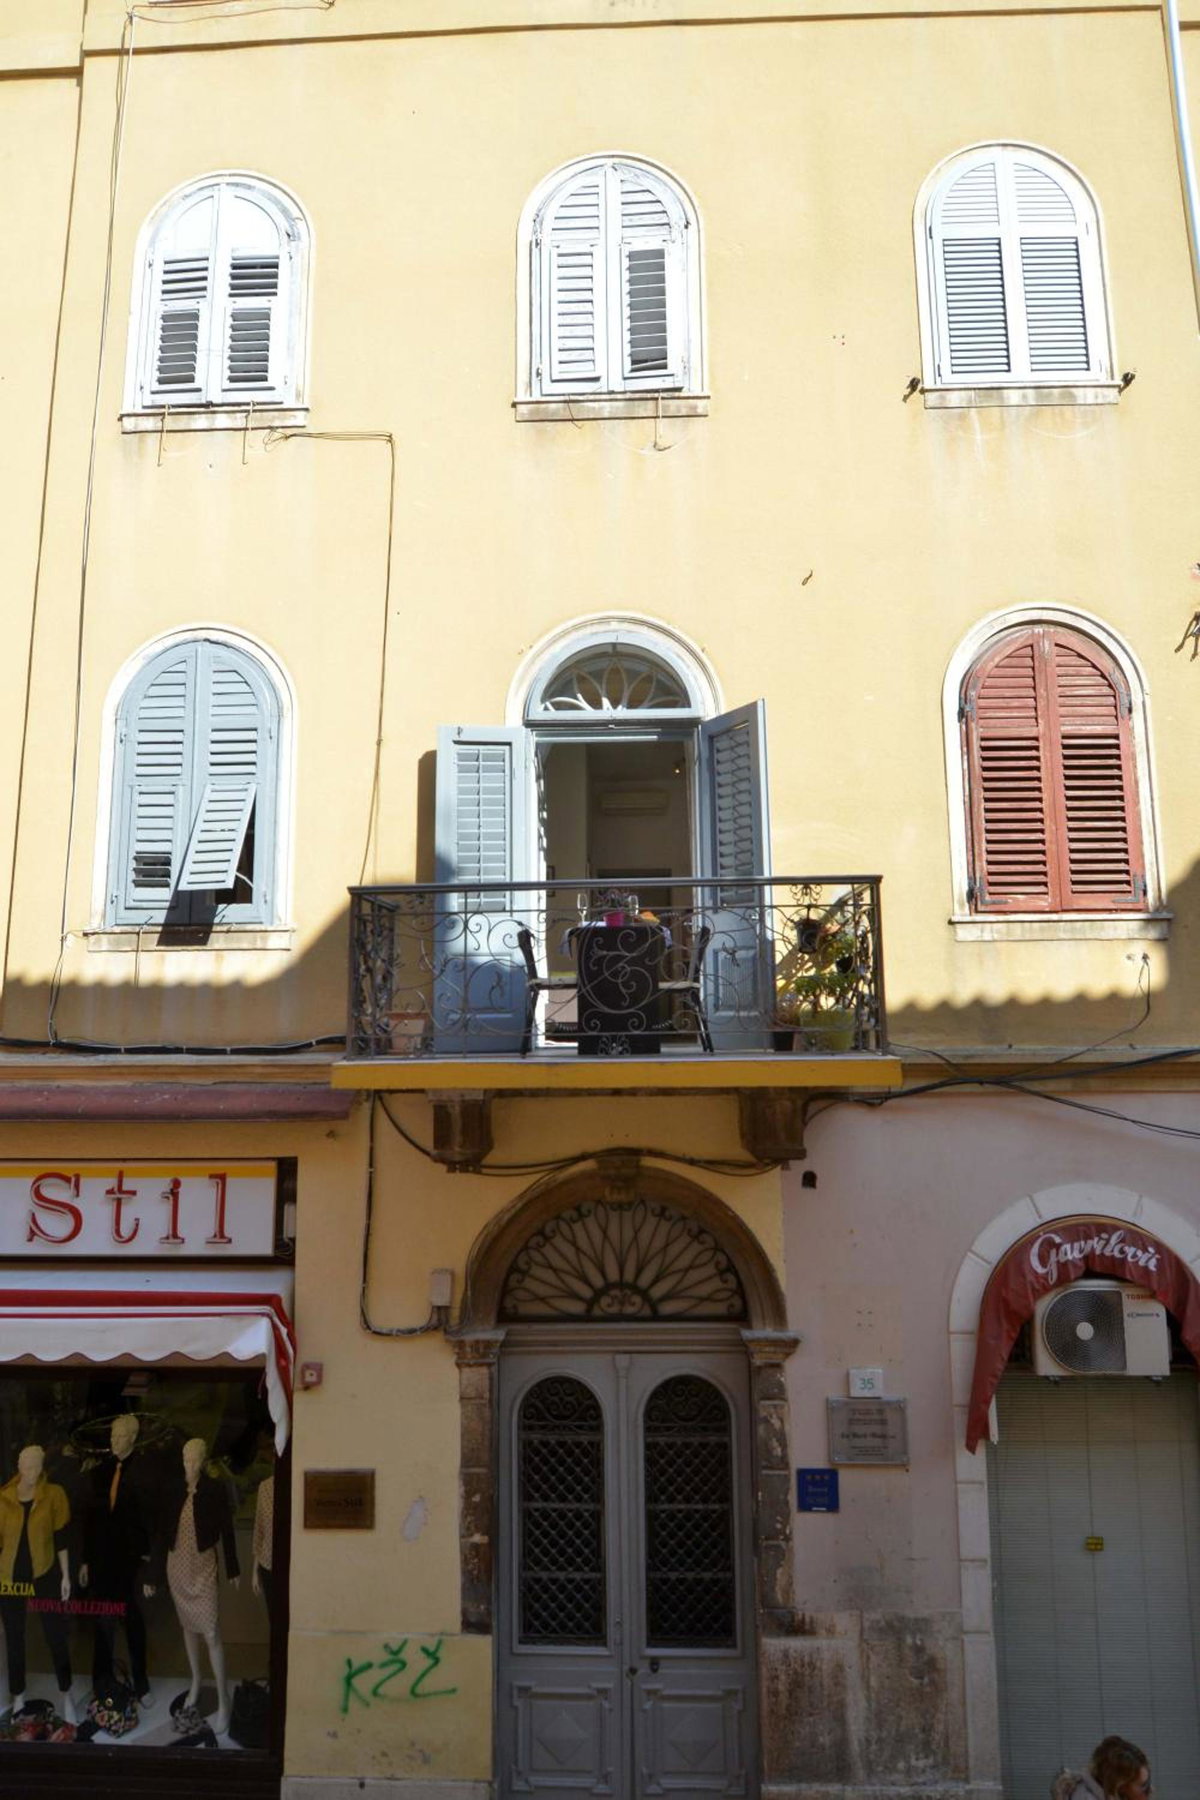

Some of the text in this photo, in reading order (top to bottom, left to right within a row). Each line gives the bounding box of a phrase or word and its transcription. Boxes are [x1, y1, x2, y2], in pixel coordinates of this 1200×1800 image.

[26, 1170, 233, 1245] Stil
[859, 1377, 874, 1390] 35
[0, 1583, 36, 1596] EKCIJA
